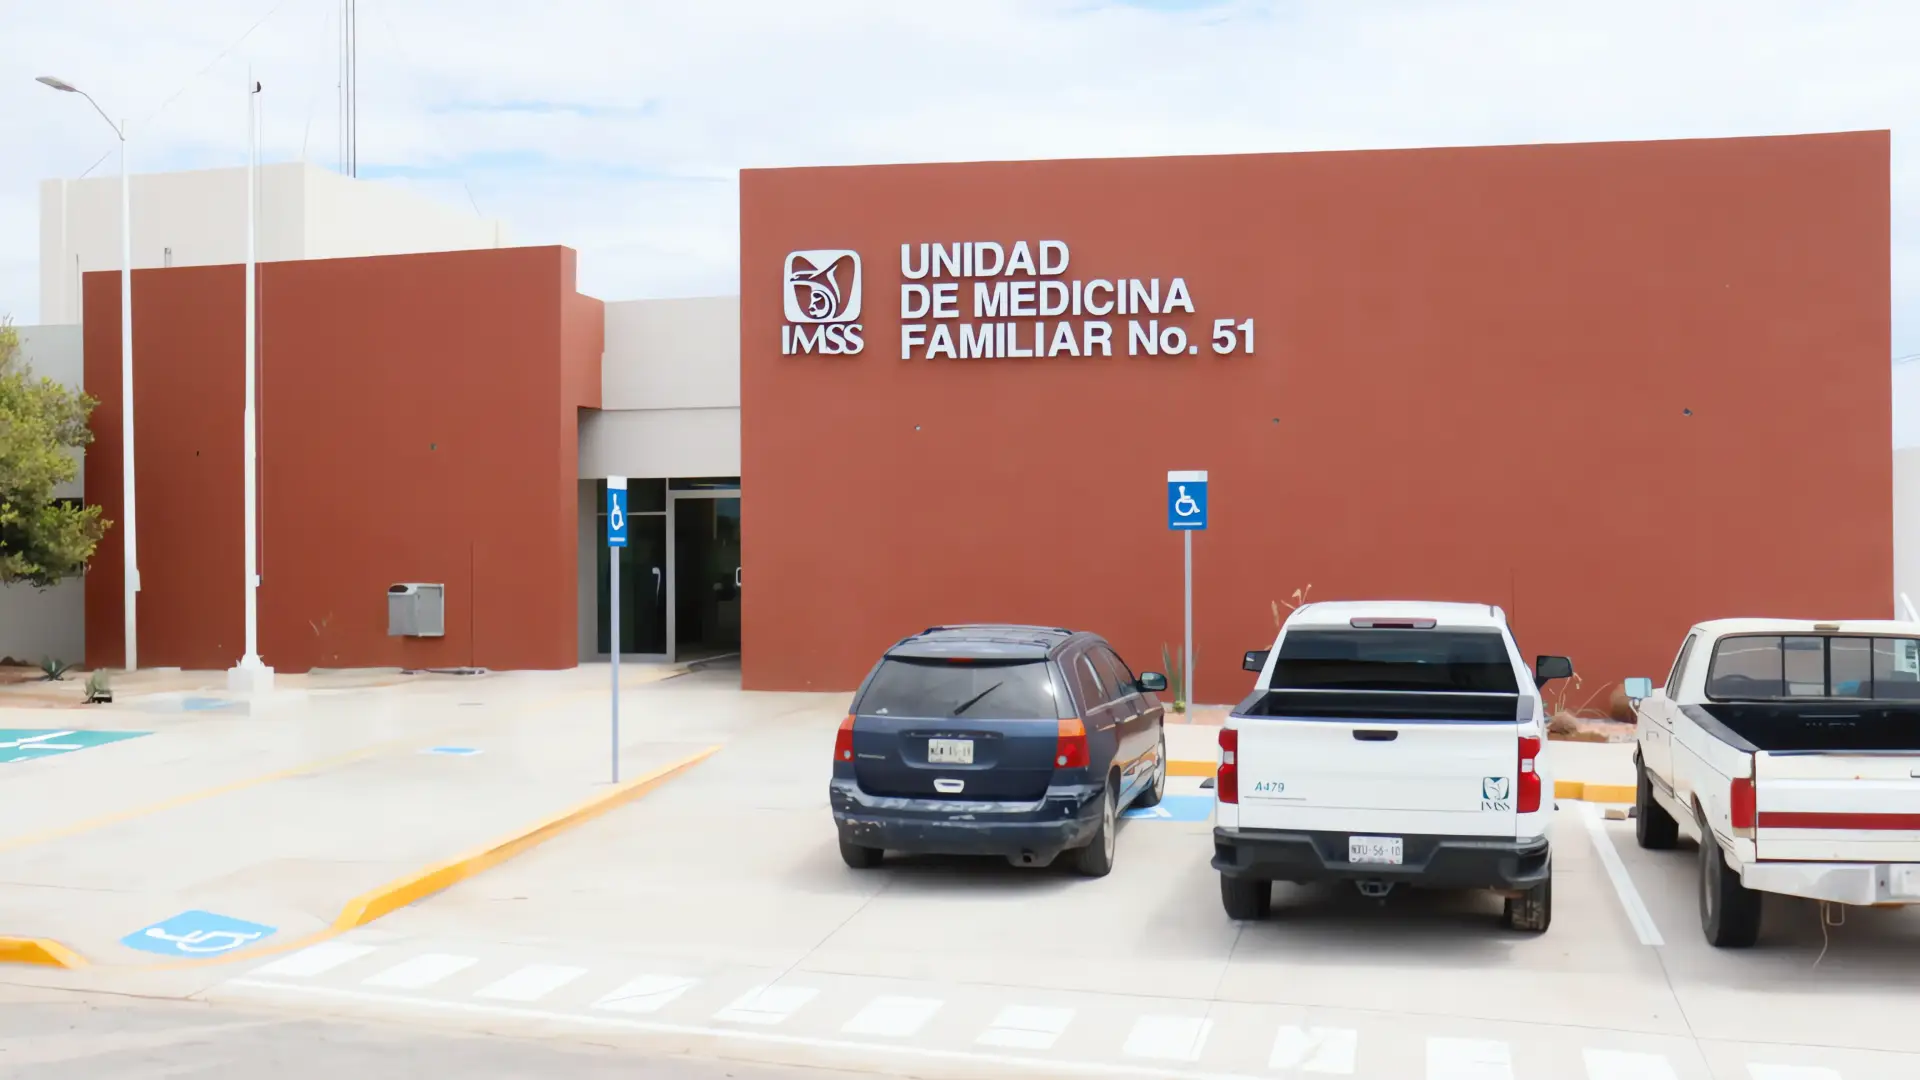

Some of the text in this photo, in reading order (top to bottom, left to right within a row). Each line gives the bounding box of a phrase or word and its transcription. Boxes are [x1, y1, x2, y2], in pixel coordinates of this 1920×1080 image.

[900, 239, 1070, 279] UNIDAD
[900, 277, 1195, 319] DE MEDICINA
[781, 323, 865, 355] IMSS
[901, 317, 1254, 360] FAMILIAR No. 51
